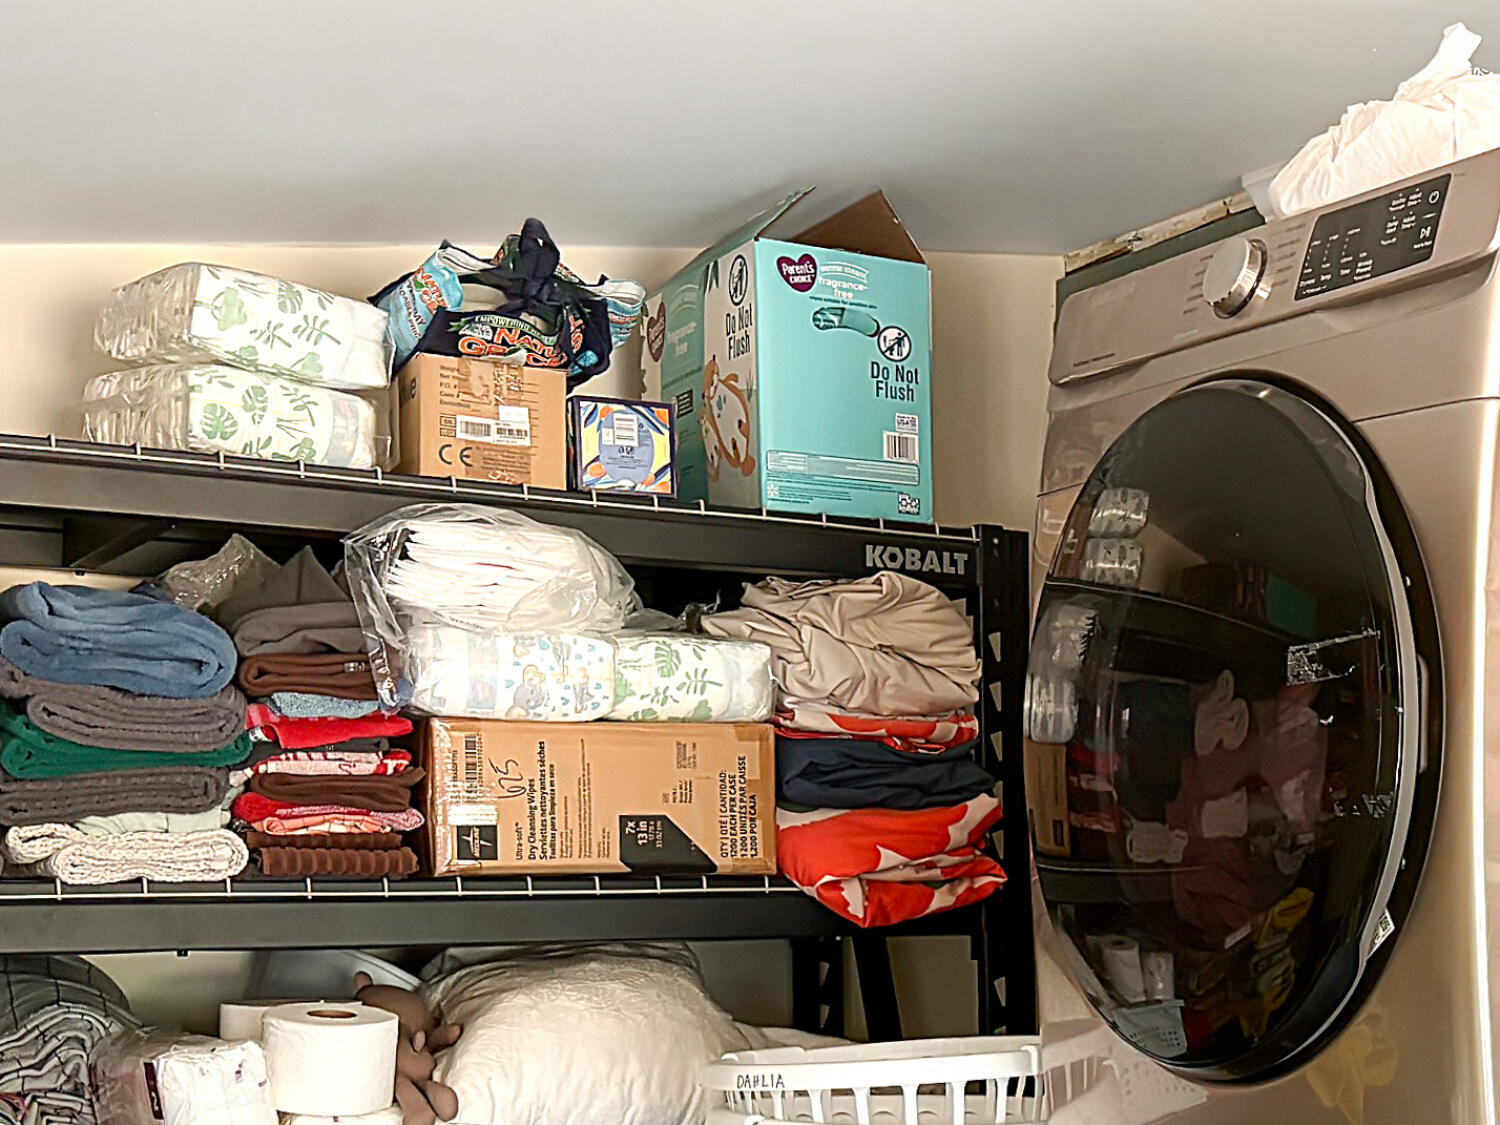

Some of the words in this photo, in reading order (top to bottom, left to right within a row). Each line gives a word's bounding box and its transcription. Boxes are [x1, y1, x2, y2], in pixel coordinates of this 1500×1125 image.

[725, 312, 736, 336] Do
[738, 303, 752, 331] Not
[728, 330, 750, 360] Flush
[871, 361, 889, 380] Do
[895, 365, 919, 385] Not
[876, 381, 914, 402] Flush
[865, 544, 968, 575] KOBALT
[738, 756, 746, 785] CAISSE
[527, 779, 537, 804] Wipes
[539, 769, 548, 817] nettoyantes
[719, 770, 727, 813] CANTIDAD:
[728, 774, 736, 795] CASE
[528, 805, 538, 843] Cleansing
[637, 821, 648, 831] in
[719, 820, 728, 835] QTÉ
[729, 815, 737, 836] EACH
[738, 805, 747, 835] UNITÉS
[539, 819, 547, 860] Serviettes
[638, 833, 648, 845] 13
[720, 841, 728, 858] QTY
[528, 846, 538, 860] Dry
[736, 1073, 786, 1089] DAHLIA
